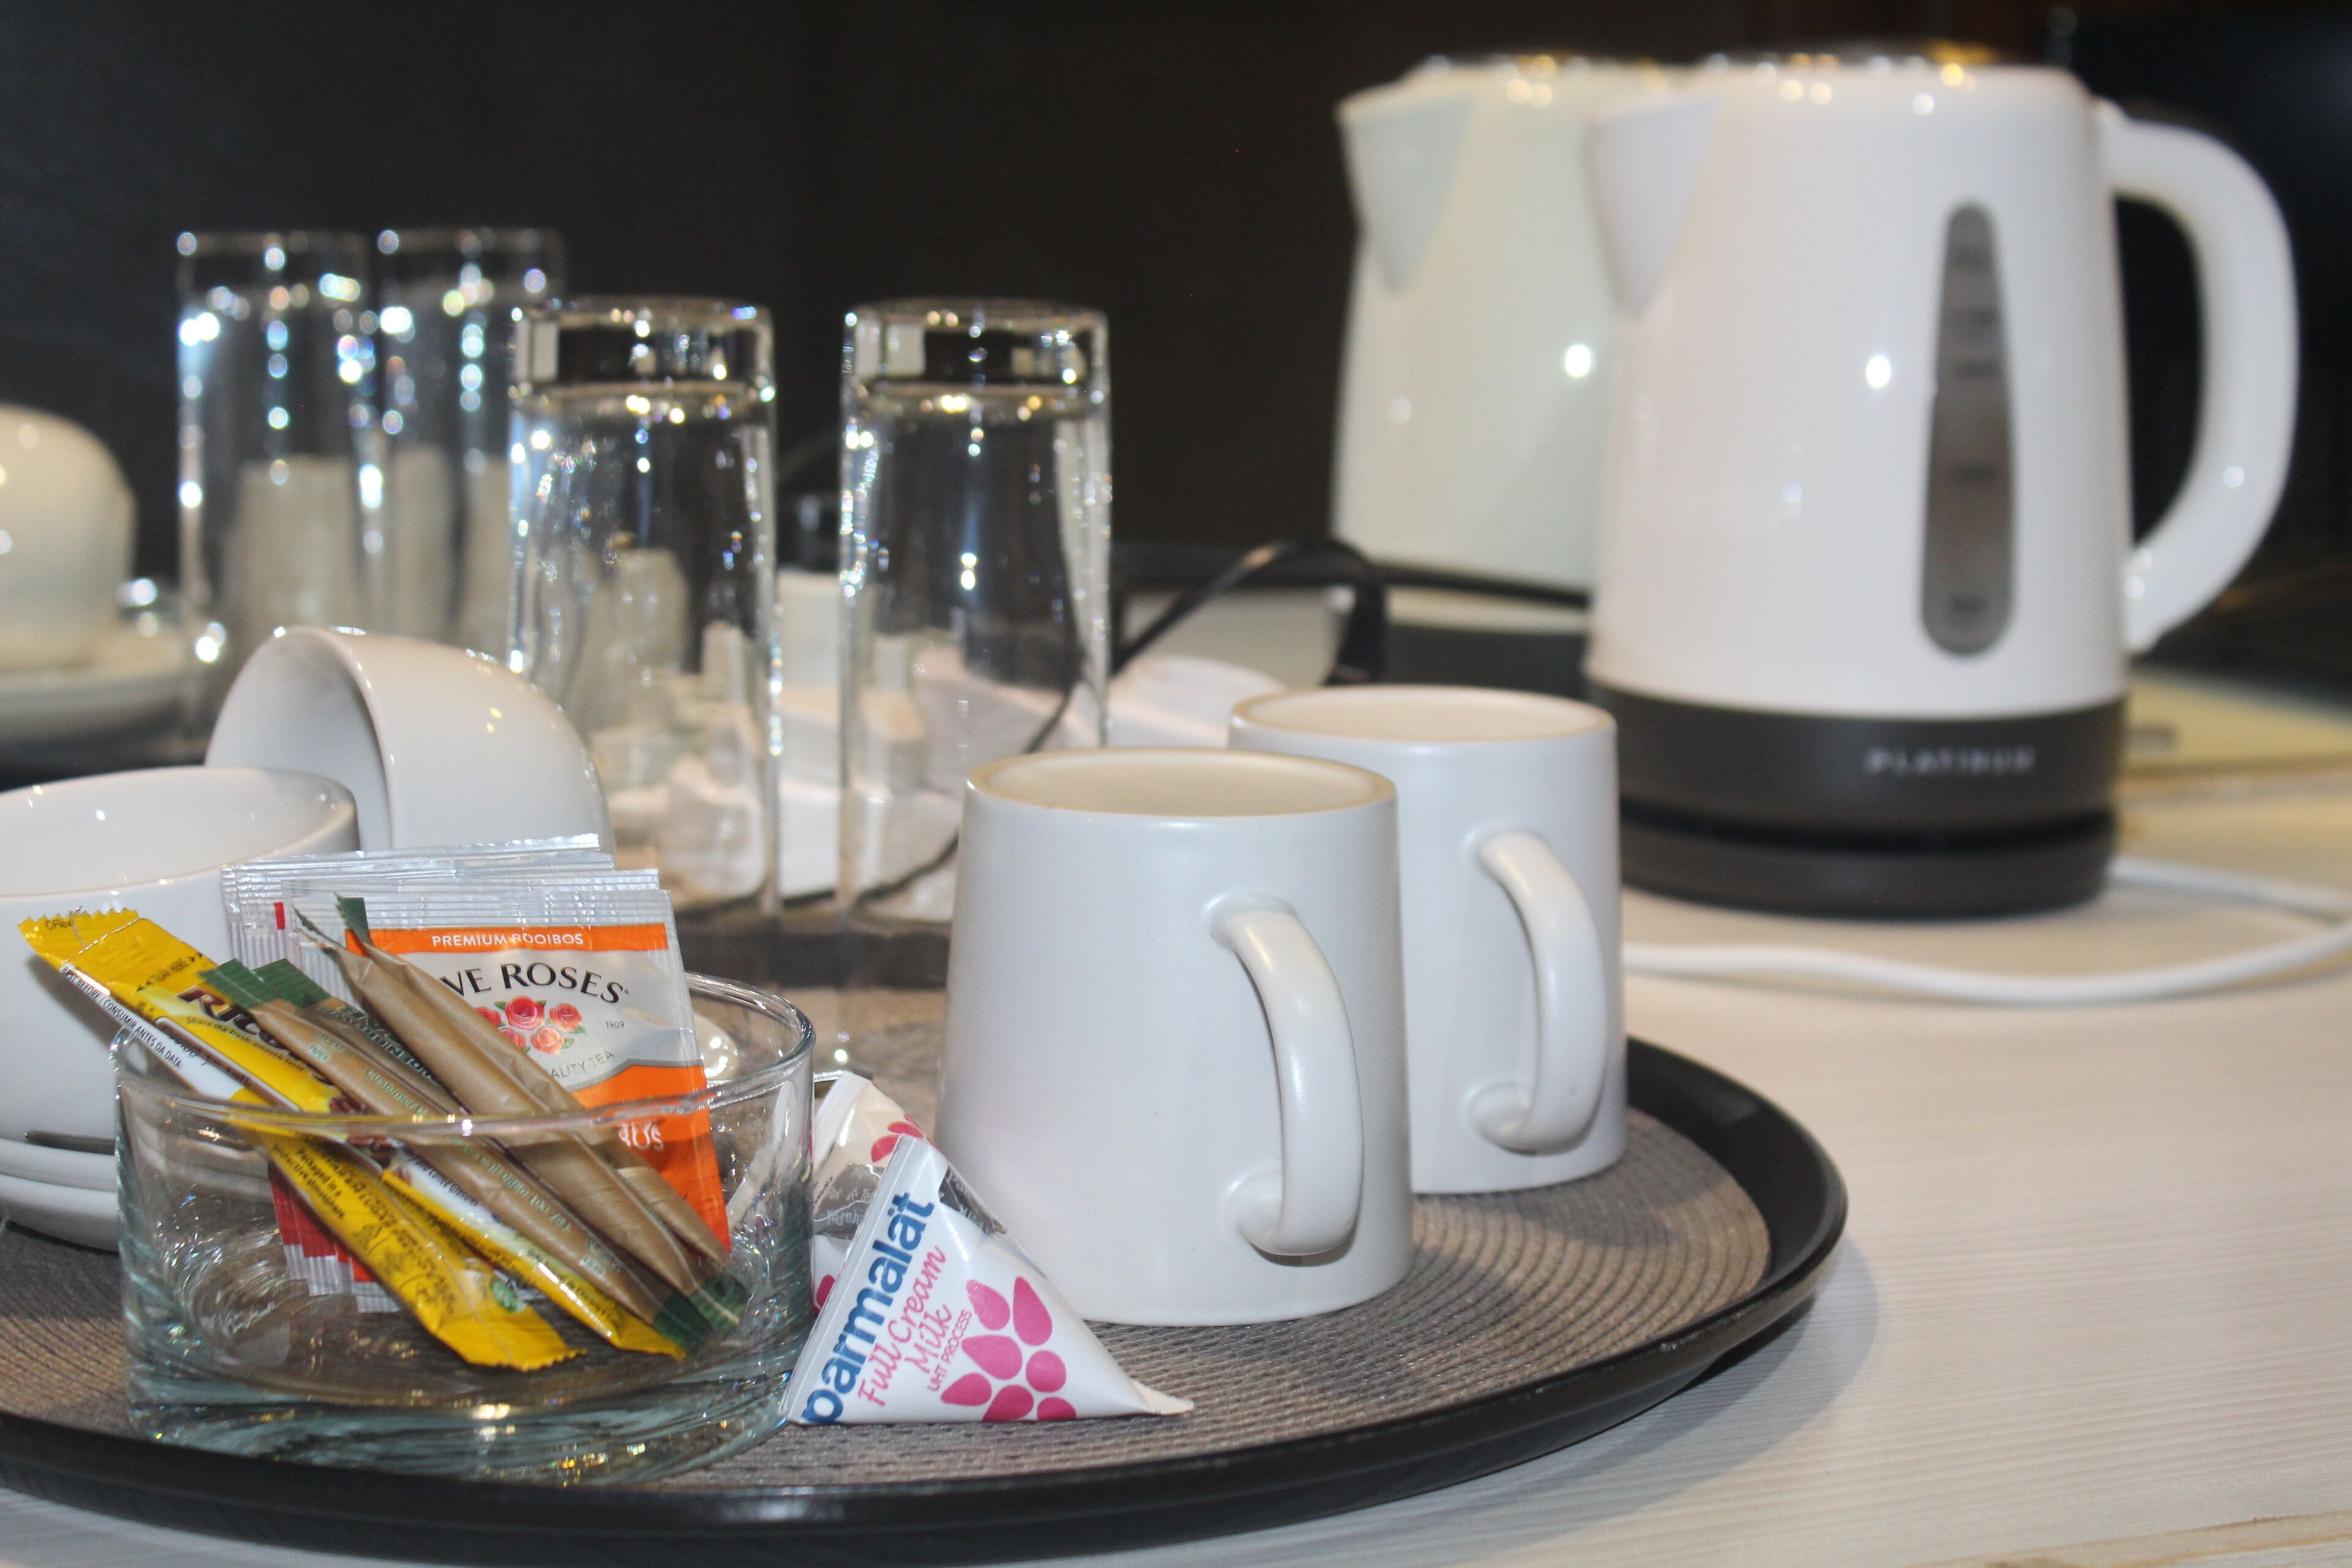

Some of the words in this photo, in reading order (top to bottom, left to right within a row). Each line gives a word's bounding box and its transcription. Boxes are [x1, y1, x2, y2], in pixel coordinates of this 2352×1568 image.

[432, 934, 507, 946] PREMIUM
[512, 933, 583, 944] ROOIBOS
[439, 968, 491, 996] VE
[500, 962, 624, 1003] ROSES
[103, 999, 138, 1029] CONSUMIR
[135, 1027, 158, 1046] ANTES
[155, 1042, 164, 1054] DA
[606, 1020, 625, 1029] 1909
[551, 1061, 586, 1079] ALITY
[588, 1049, 615, 1069] TEA
[800, 1192, 935, 1423] parmalat
[858, 1343, 902, 1406] Full
[888, 1245, 946, 1343] Cream
[905, 1304, 952, 1374] Milk
[927, 1364, 948, 1392] UHT
[941, 1309, 973, 1364] PROCESS
